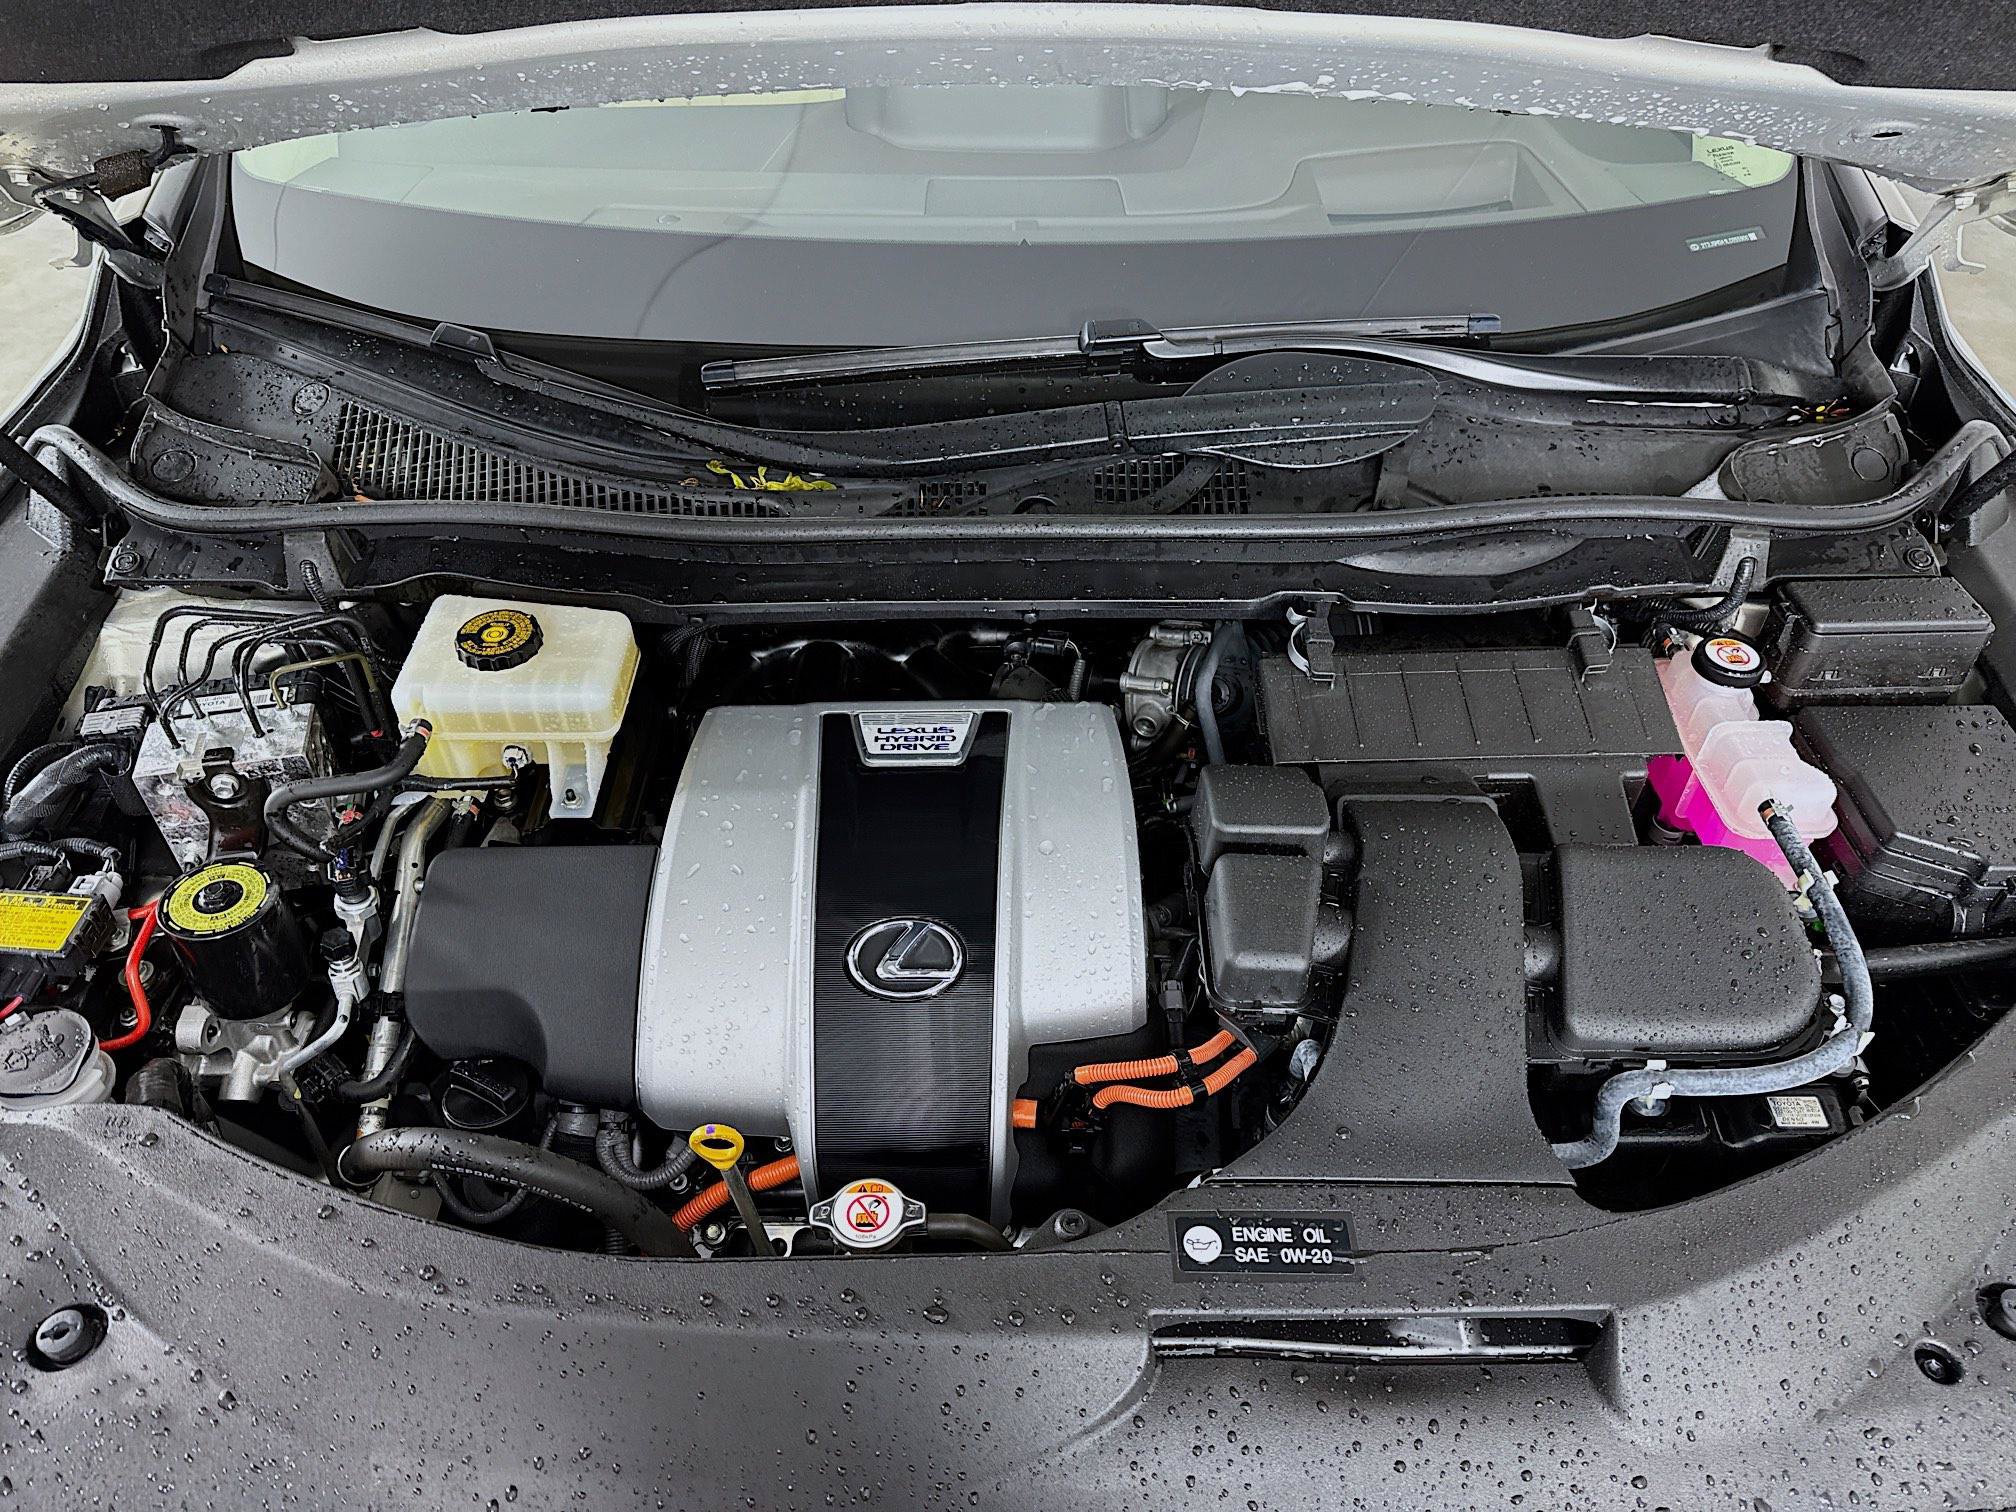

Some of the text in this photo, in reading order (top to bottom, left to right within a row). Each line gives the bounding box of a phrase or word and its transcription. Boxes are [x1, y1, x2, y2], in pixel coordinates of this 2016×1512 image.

[877, 726, 954, 734] LEXUS
[874, 735, 957, 743] HYBRID
[880, 743, 950, 751] DRIVE
[1231, 1226, 1332, 1244] ENGINE OIL
[1234, 1246, 1334, 1265] SAE 0W-20
